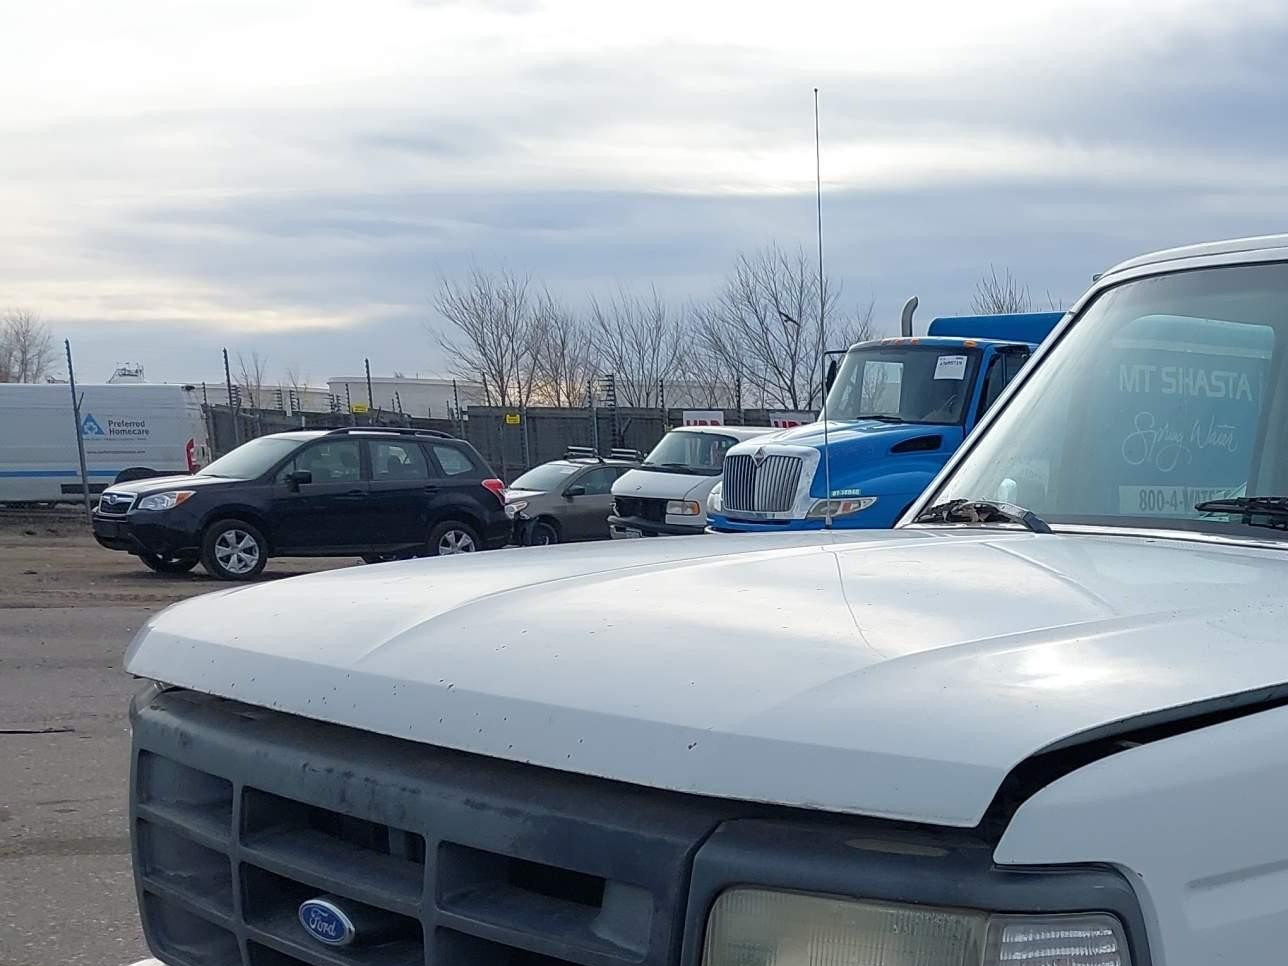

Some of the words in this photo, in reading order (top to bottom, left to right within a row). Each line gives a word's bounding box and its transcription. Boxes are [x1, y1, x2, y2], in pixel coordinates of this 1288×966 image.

[1119, 364, 1157, 393] MT
[1160, 366, 1253, 401] SHASTA
[108, 419, 146, 428] Preferred
[109, 428, 150, 436] Homecare
[309, 907, 337, 937] Ford
